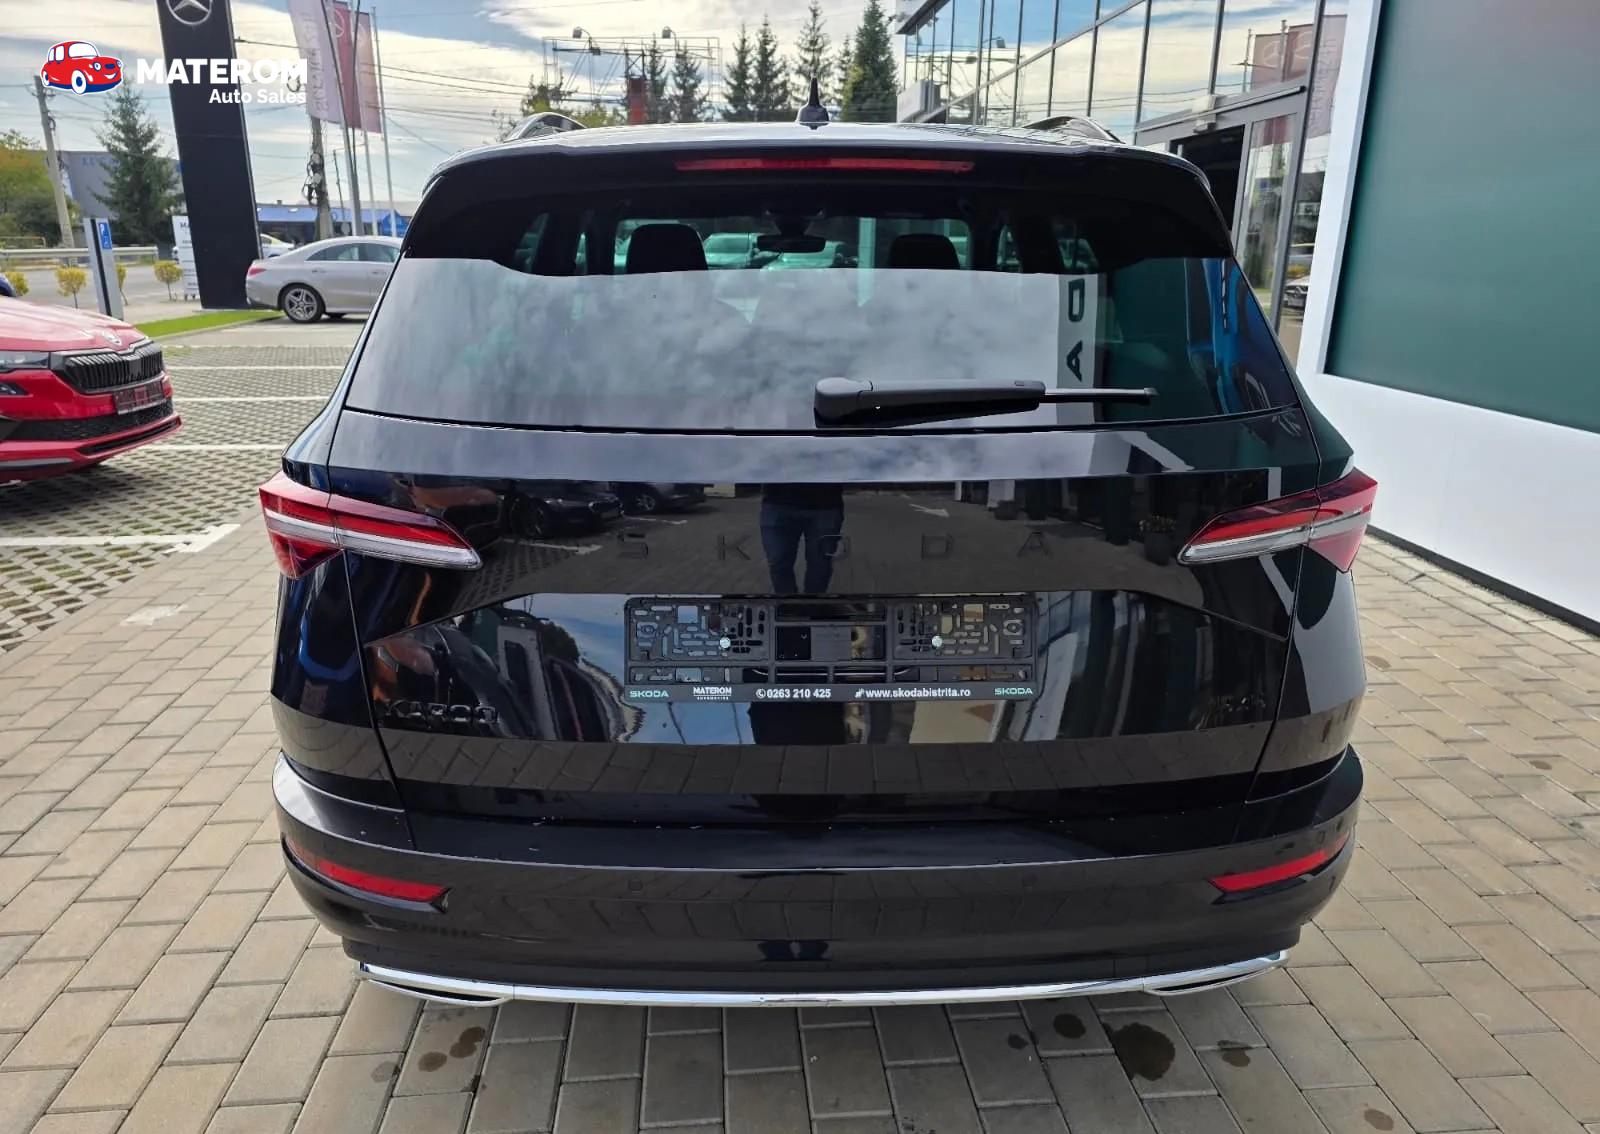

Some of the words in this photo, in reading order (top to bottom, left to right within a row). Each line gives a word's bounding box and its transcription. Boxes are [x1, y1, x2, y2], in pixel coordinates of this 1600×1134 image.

[617, 531, 1053, 561] SKODA
[629, 690, 670, 698] SKODA
[693, 686, 732, 695] MATEROM
[766, 688, 791, 698] 0263
[792, 688, 811, 698] 210
[812, 688, 832, 698] 425
[865, 687, 971, 698] www.skodabistrita.ro
[994, 687, 1034, 696] SKODA
